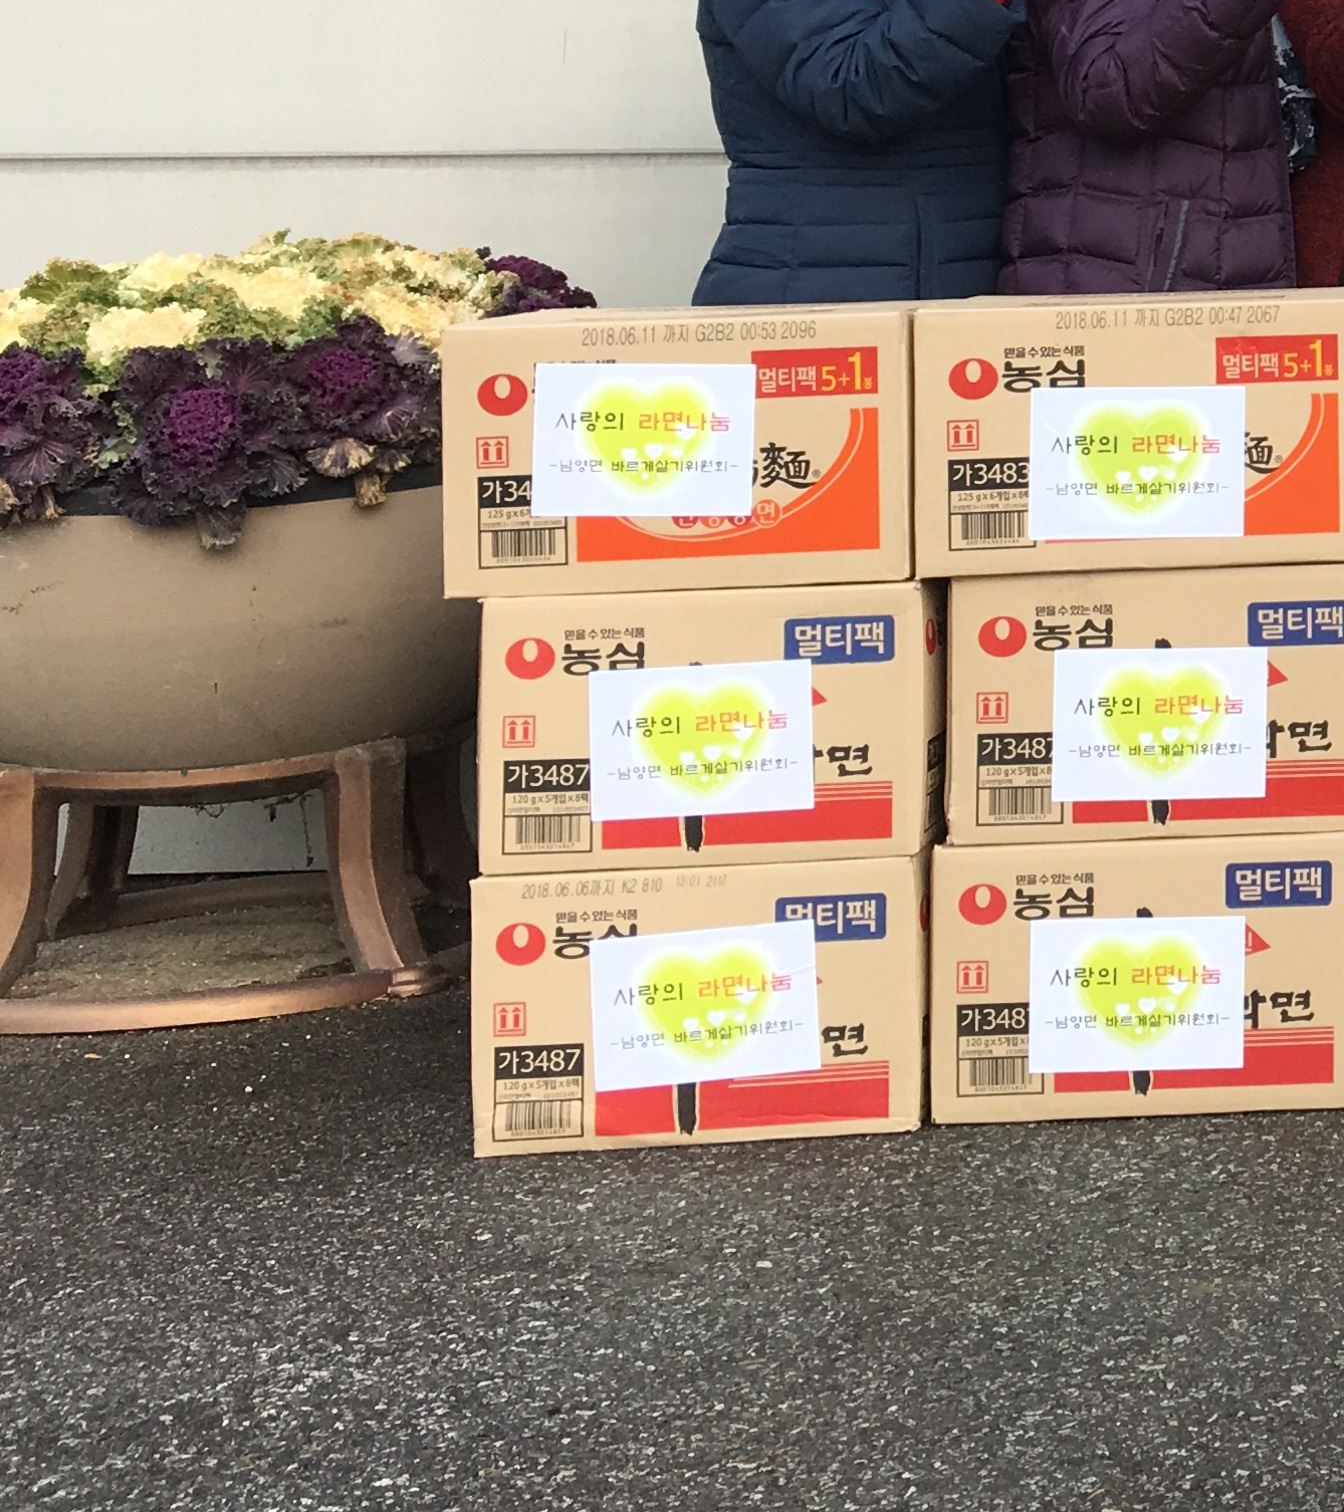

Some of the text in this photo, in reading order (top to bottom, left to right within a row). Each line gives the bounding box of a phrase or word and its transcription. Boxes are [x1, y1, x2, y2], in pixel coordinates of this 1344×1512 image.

[1056, 305, 1279, 329] 2018.06.11 까지 G2B2 00:47 2067
[582, 321, 816, 347] 2018.06.11 까지 G2B2 00:53 2096
[758, 366, 816, 391] 멀티팩
[1002, 360, 1085, 392] 농심
[1223, 354, 1279, 379] 멀티팩
[555, 411, 730, 432] 사랑의 라면나눔
[1051, 435, 1222, 455] 사랑의 라면나눔
[952, 462, 1029, 485] 가3483
[1033, 617, 1113, 650] 농심
[1257, 606, 1344, 639] 멀티팩
[795, 622, 885, 655] 멀티팩
[562, 642, 645, 675] 농심
[1074, 695, 1243, 716] 사랑의 라면나눔
[612, 710, 788, 737] 사랑의 라면나눔
[507, 764, 589, 789] 가3487
[1236, 866, 1322, 901] 멀티팩
[1013, 886, 1094, 920] 농심
[1051, 964, 1222, 987] 사랑의 라면나눔
[613, 974, 792, 1007] 사랑의 라면나눔
[499, 1049, 580, 1075] 가3487
